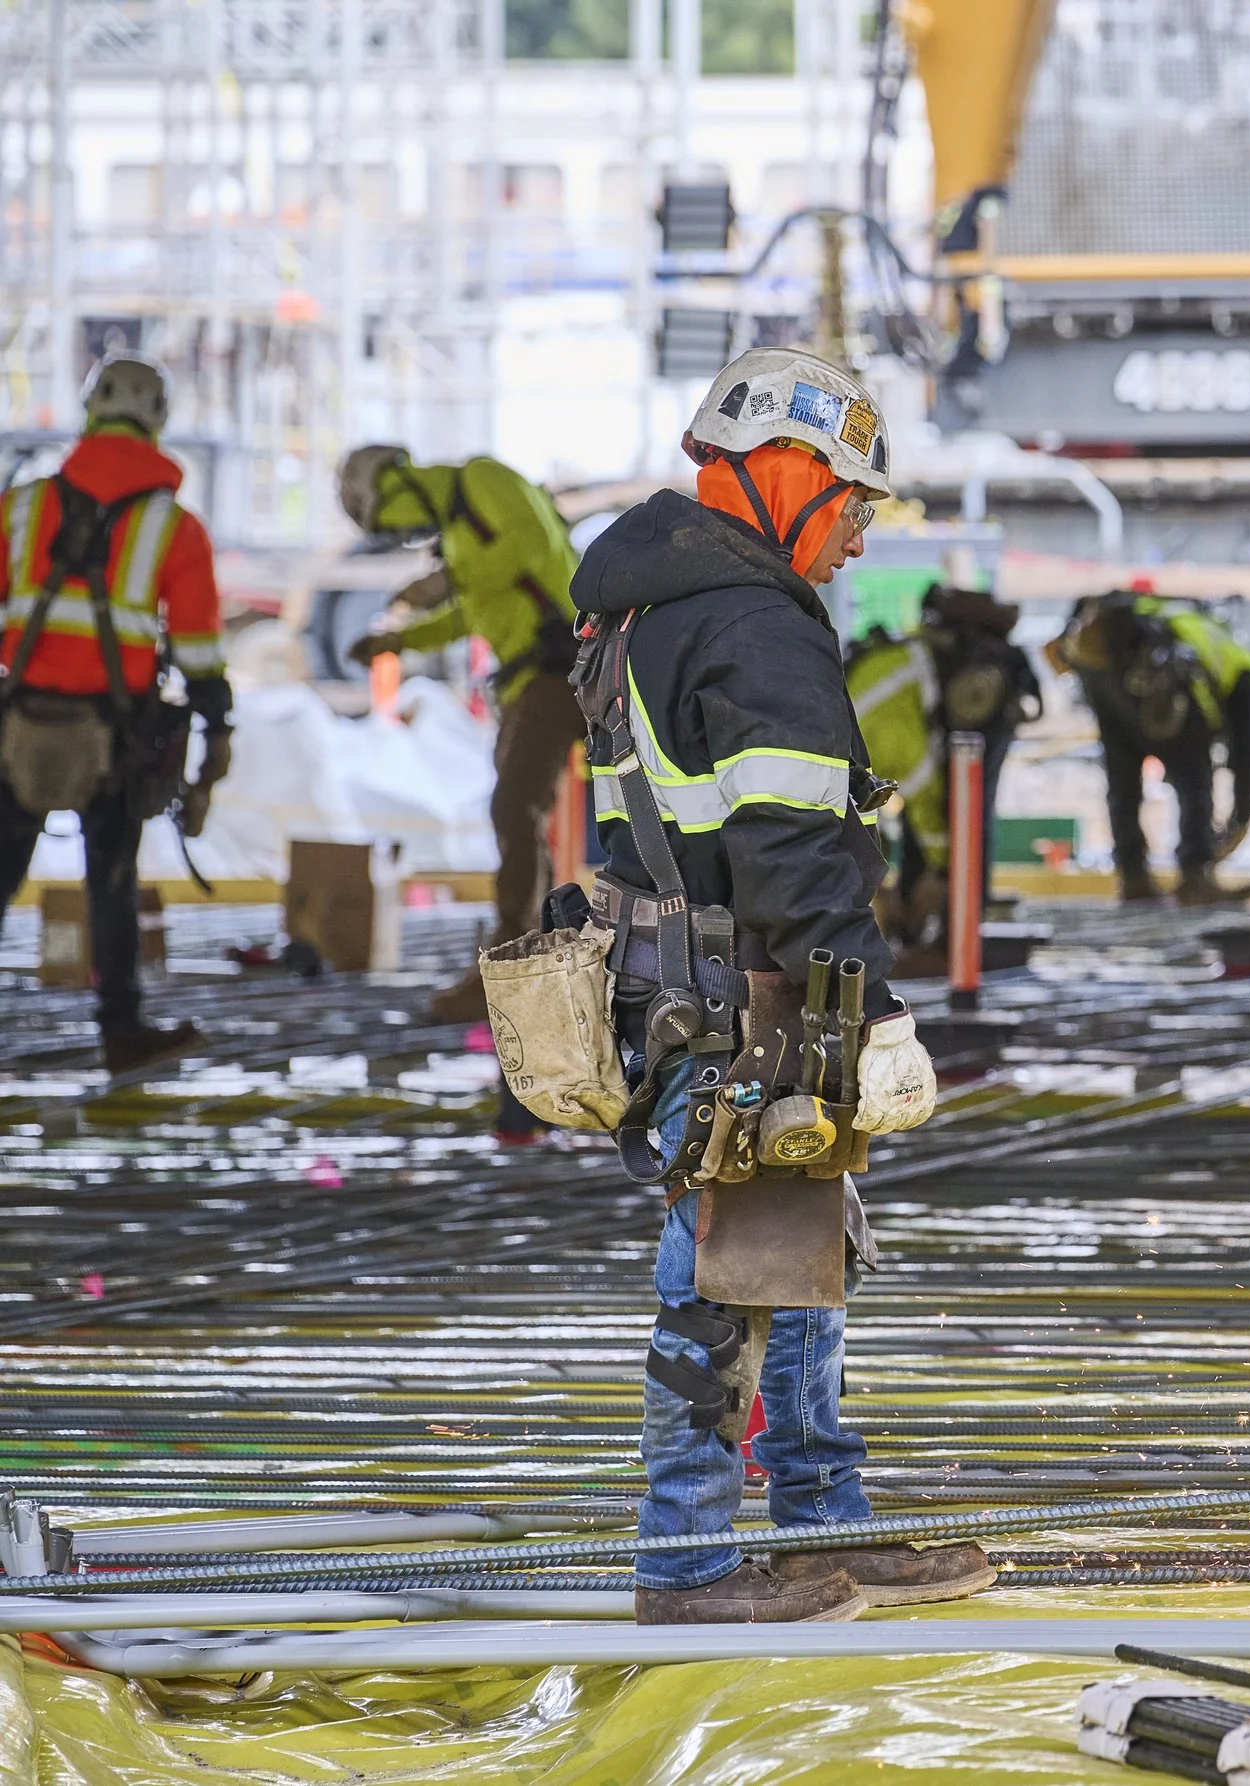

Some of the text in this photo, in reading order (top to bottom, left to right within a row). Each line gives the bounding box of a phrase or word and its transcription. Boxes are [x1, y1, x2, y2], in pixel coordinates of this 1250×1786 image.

[788, 407, 826, 430] STADIUM
[847, 432, 867, 451] TOUGH
[849, 423, 869, 443] TRADE
